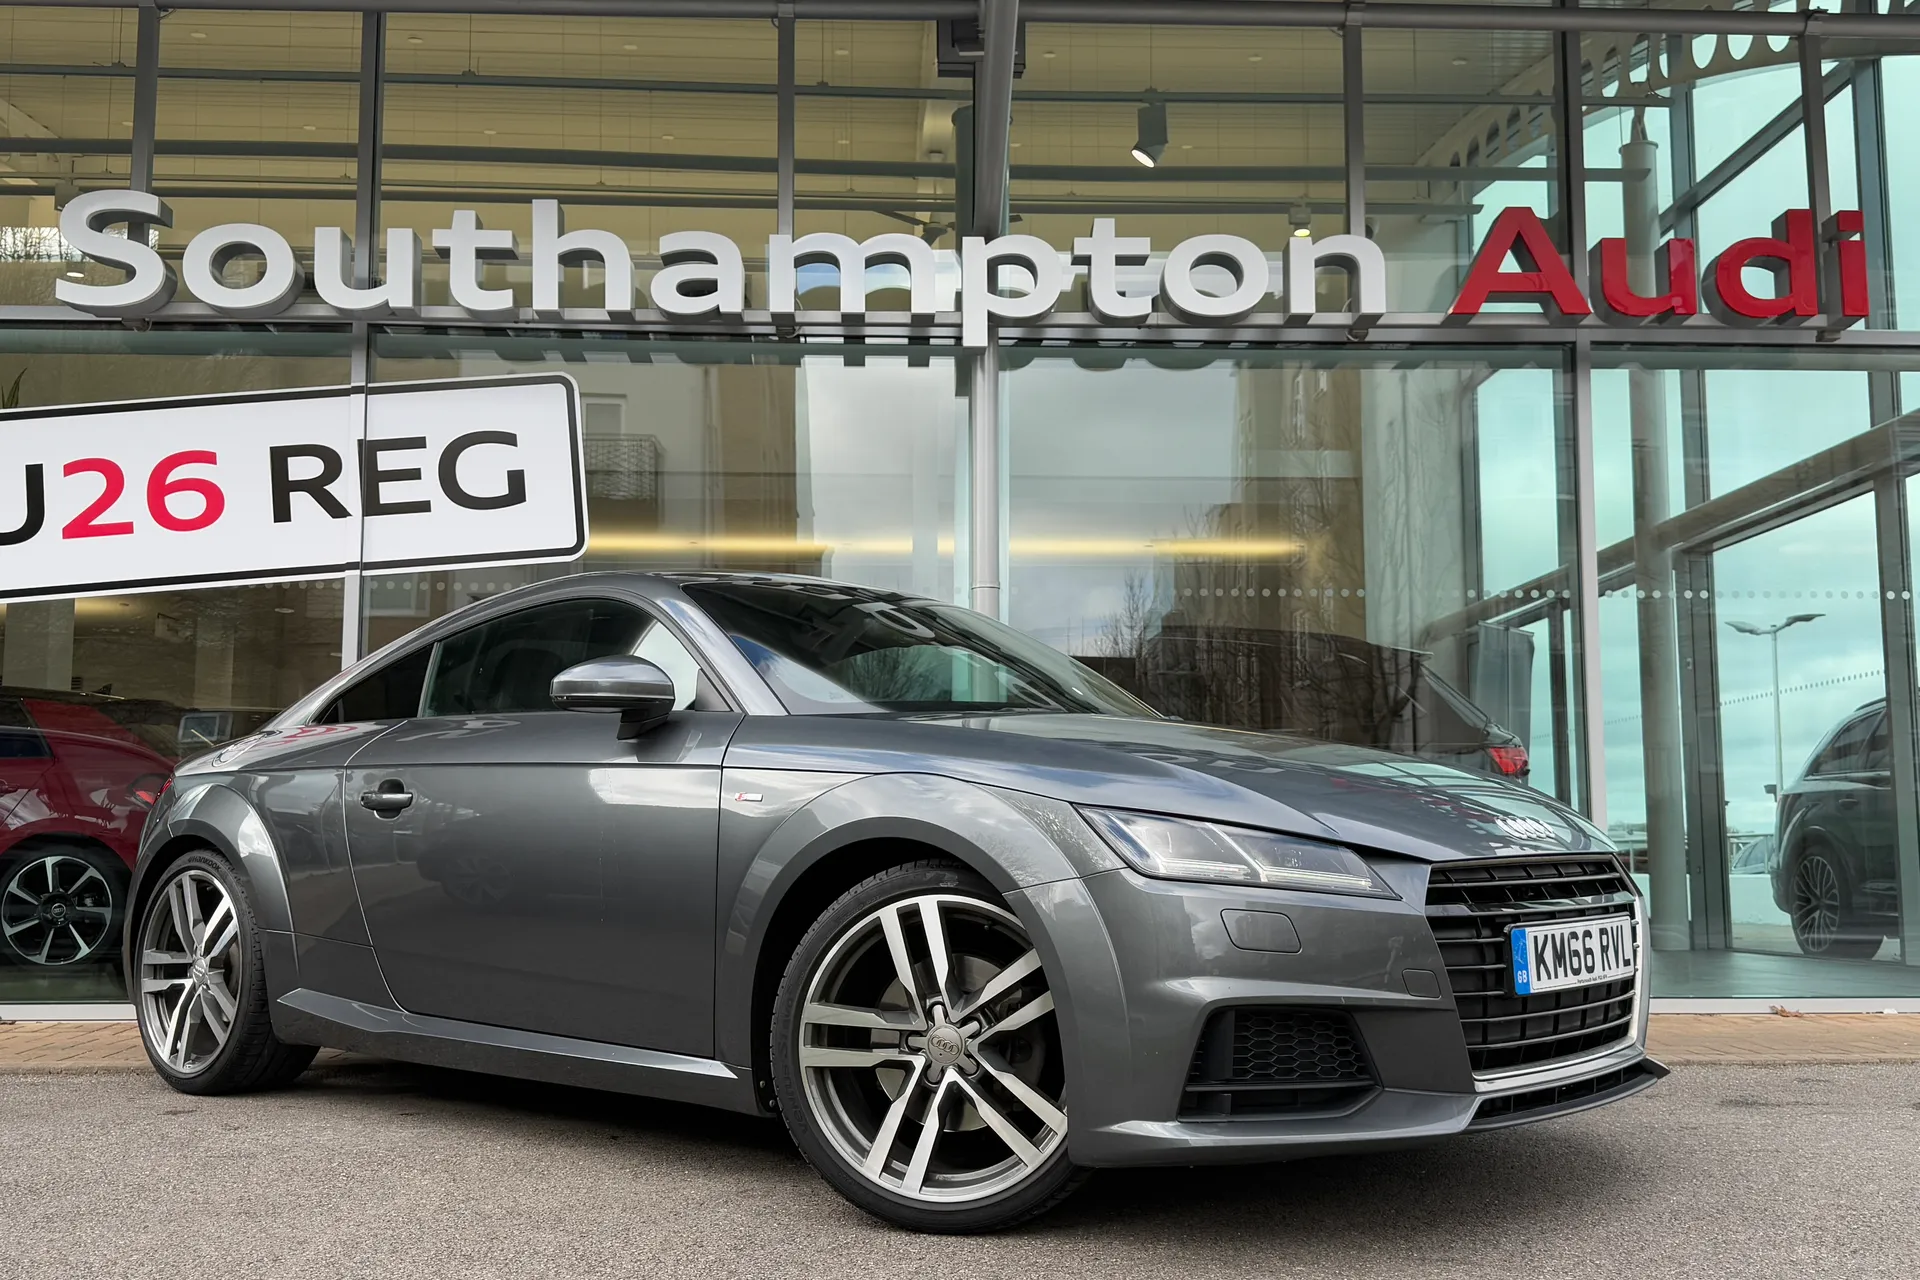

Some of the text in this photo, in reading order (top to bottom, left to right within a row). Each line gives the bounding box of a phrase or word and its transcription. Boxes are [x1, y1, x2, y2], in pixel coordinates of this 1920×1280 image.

[55, 189, 1869, 347] Southampton Audi
[269, 429, 527, 524] REG
[1517, 970, 1528, 984] GB
[1533, 924, 1632, 982] KM66 RVL
